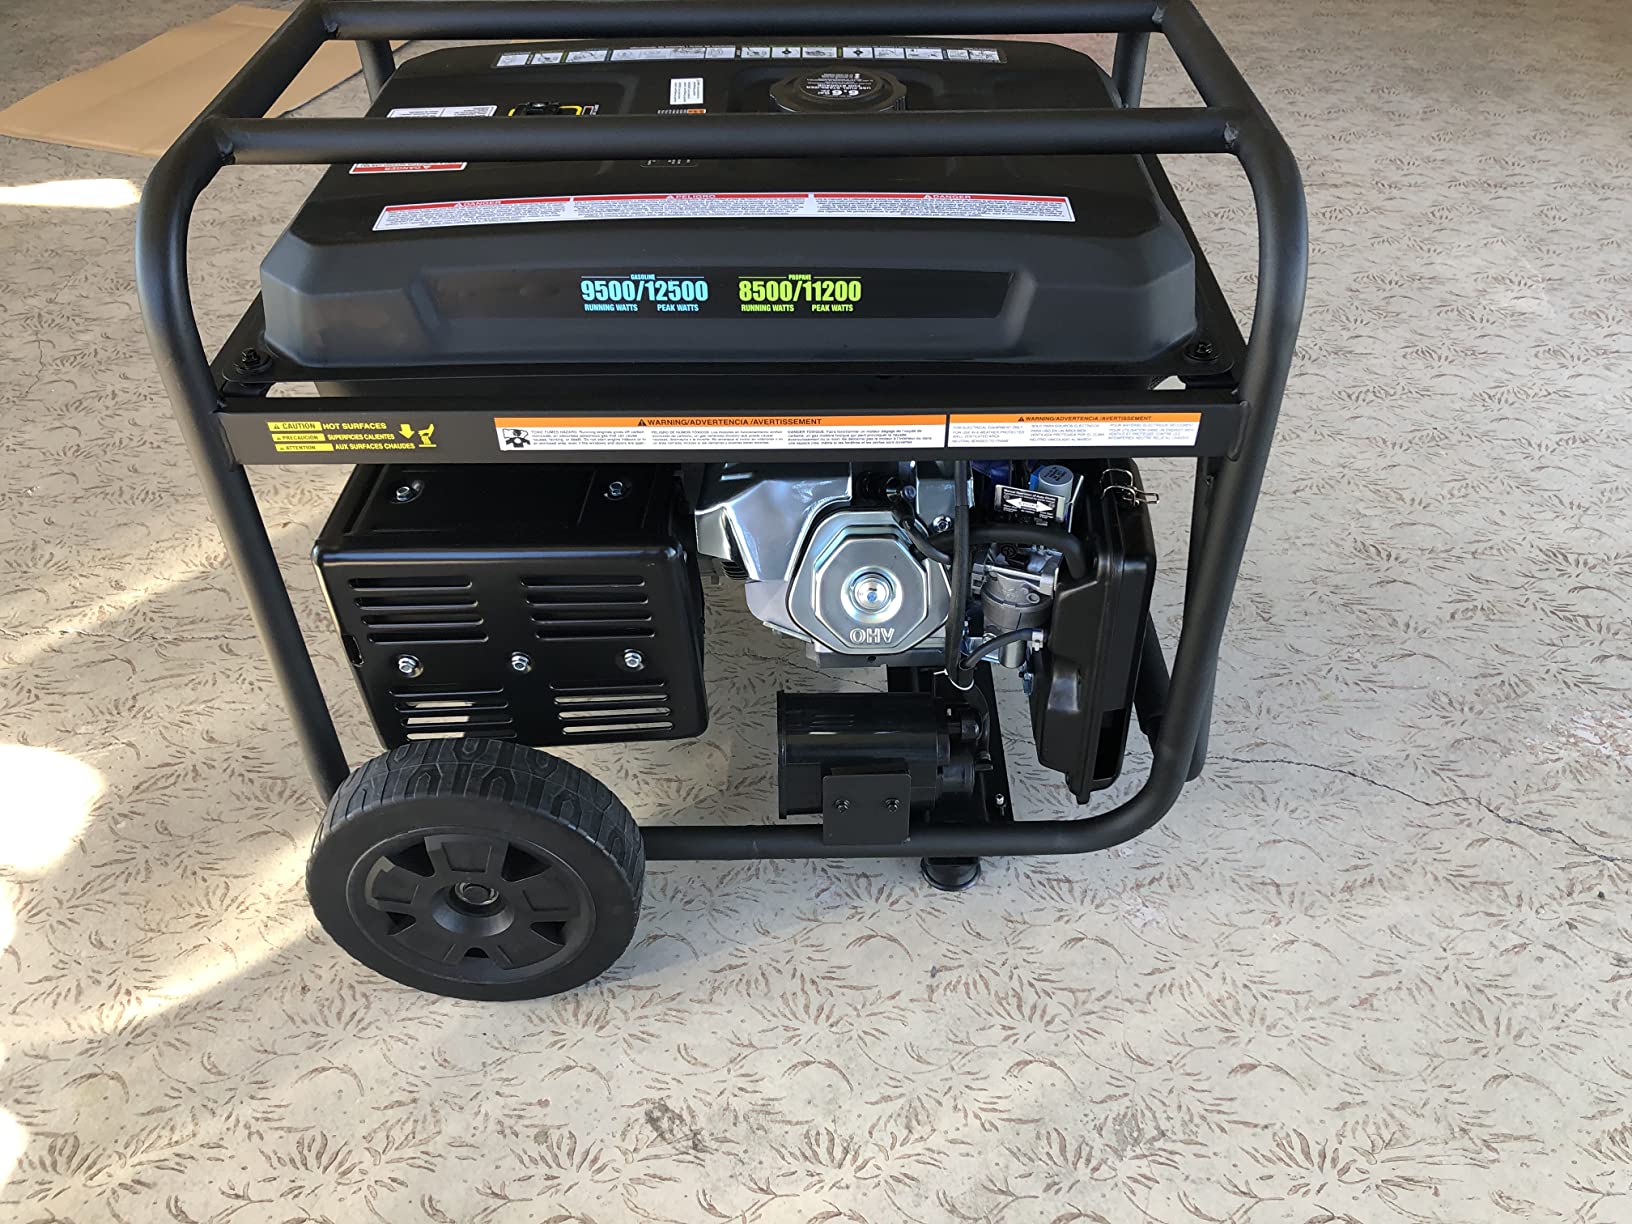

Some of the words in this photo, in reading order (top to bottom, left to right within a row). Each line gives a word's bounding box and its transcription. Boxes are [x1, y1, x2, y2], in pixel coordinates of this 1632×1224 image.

[581, 280, 709, 301] 9500/12500
[739, 280, 862, 301] 8500/11200
[584, 303, 615, 312] RUNNING
[615, 303, 638, 311] WATTS
[657, 303, 676, 312] PEAK
[676, 303, 699, 312] WATTS
[741, 304, 771, 312] RUNNING
[772, 304, 794, 312] WATTS
[811, 304, 830, 312] PEAK
[831, 304, 854, 312] WATTS
[282, 422, 316, 430] CAUTION
[322, 422, 340, 430] HOT
[341, 422, 387, 430] SURFACES
[647, 418, 750, 426] WARNING/ADVERTENCIA
[850, 627, 895, 644] OHV
